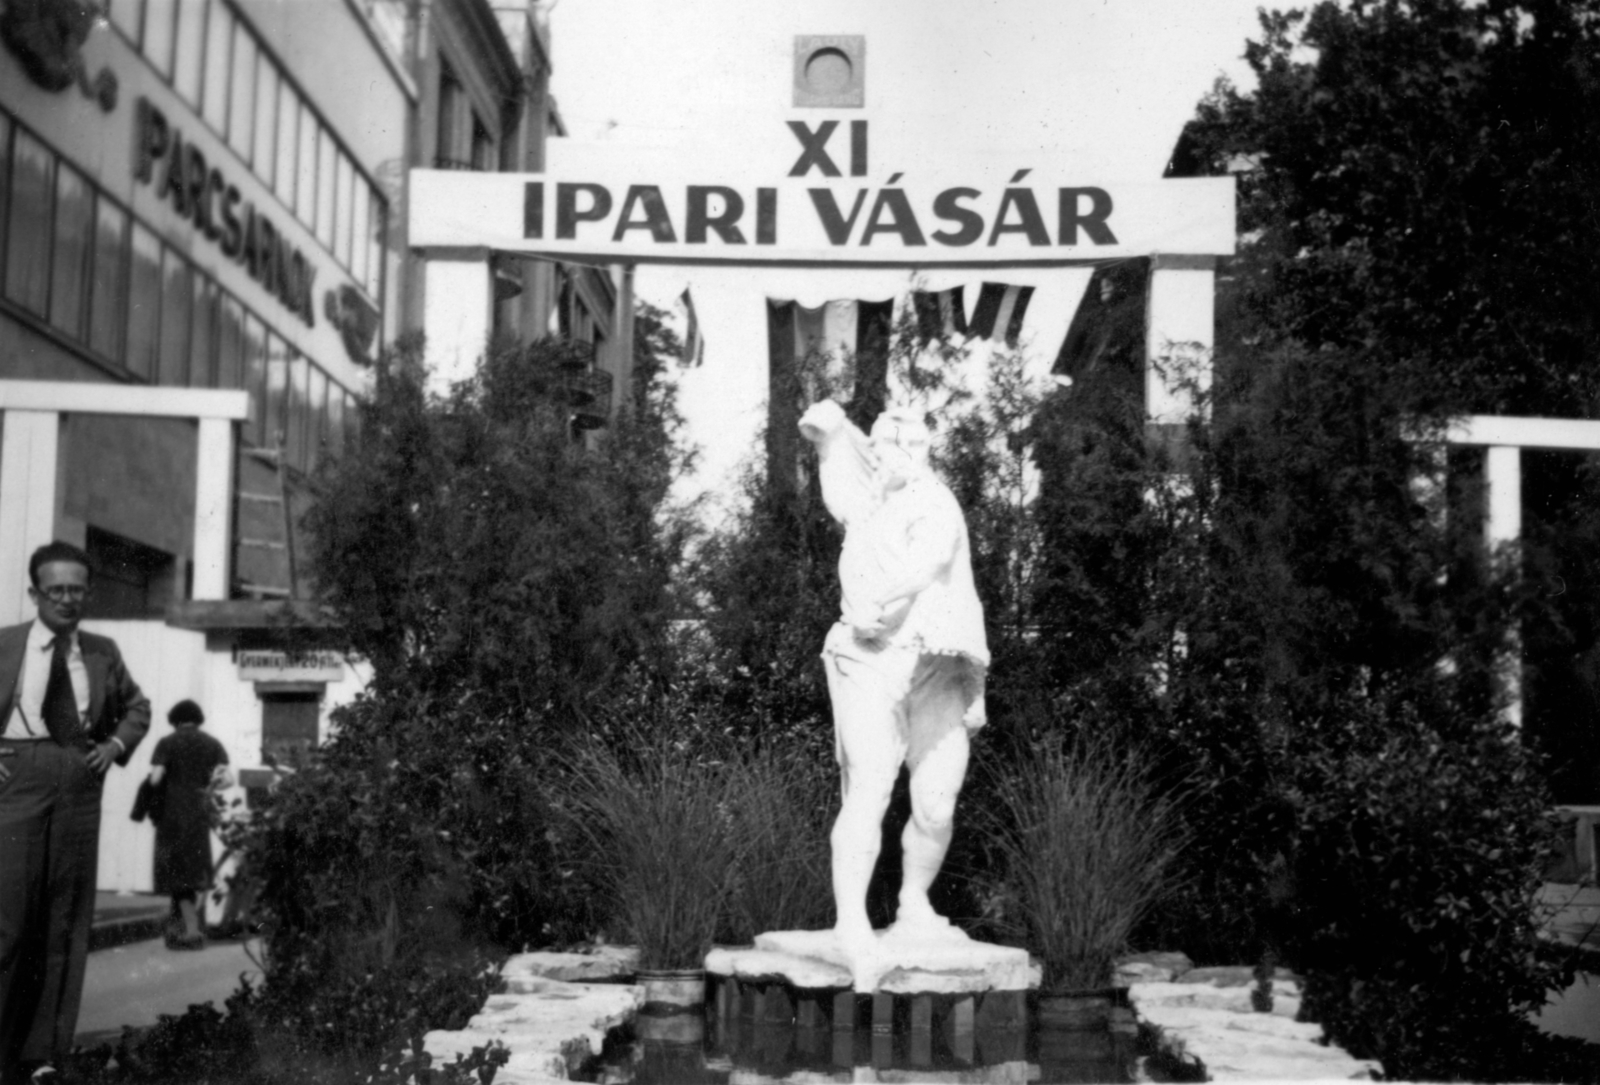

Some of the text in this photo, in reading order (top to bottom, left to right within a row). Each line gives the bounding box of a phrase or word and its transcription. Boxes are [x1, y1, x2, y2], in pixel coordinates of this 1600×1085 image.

[786, 120, 868, 177] XI
[523, 168, 1120, 247] IPARI VÁSÁR
